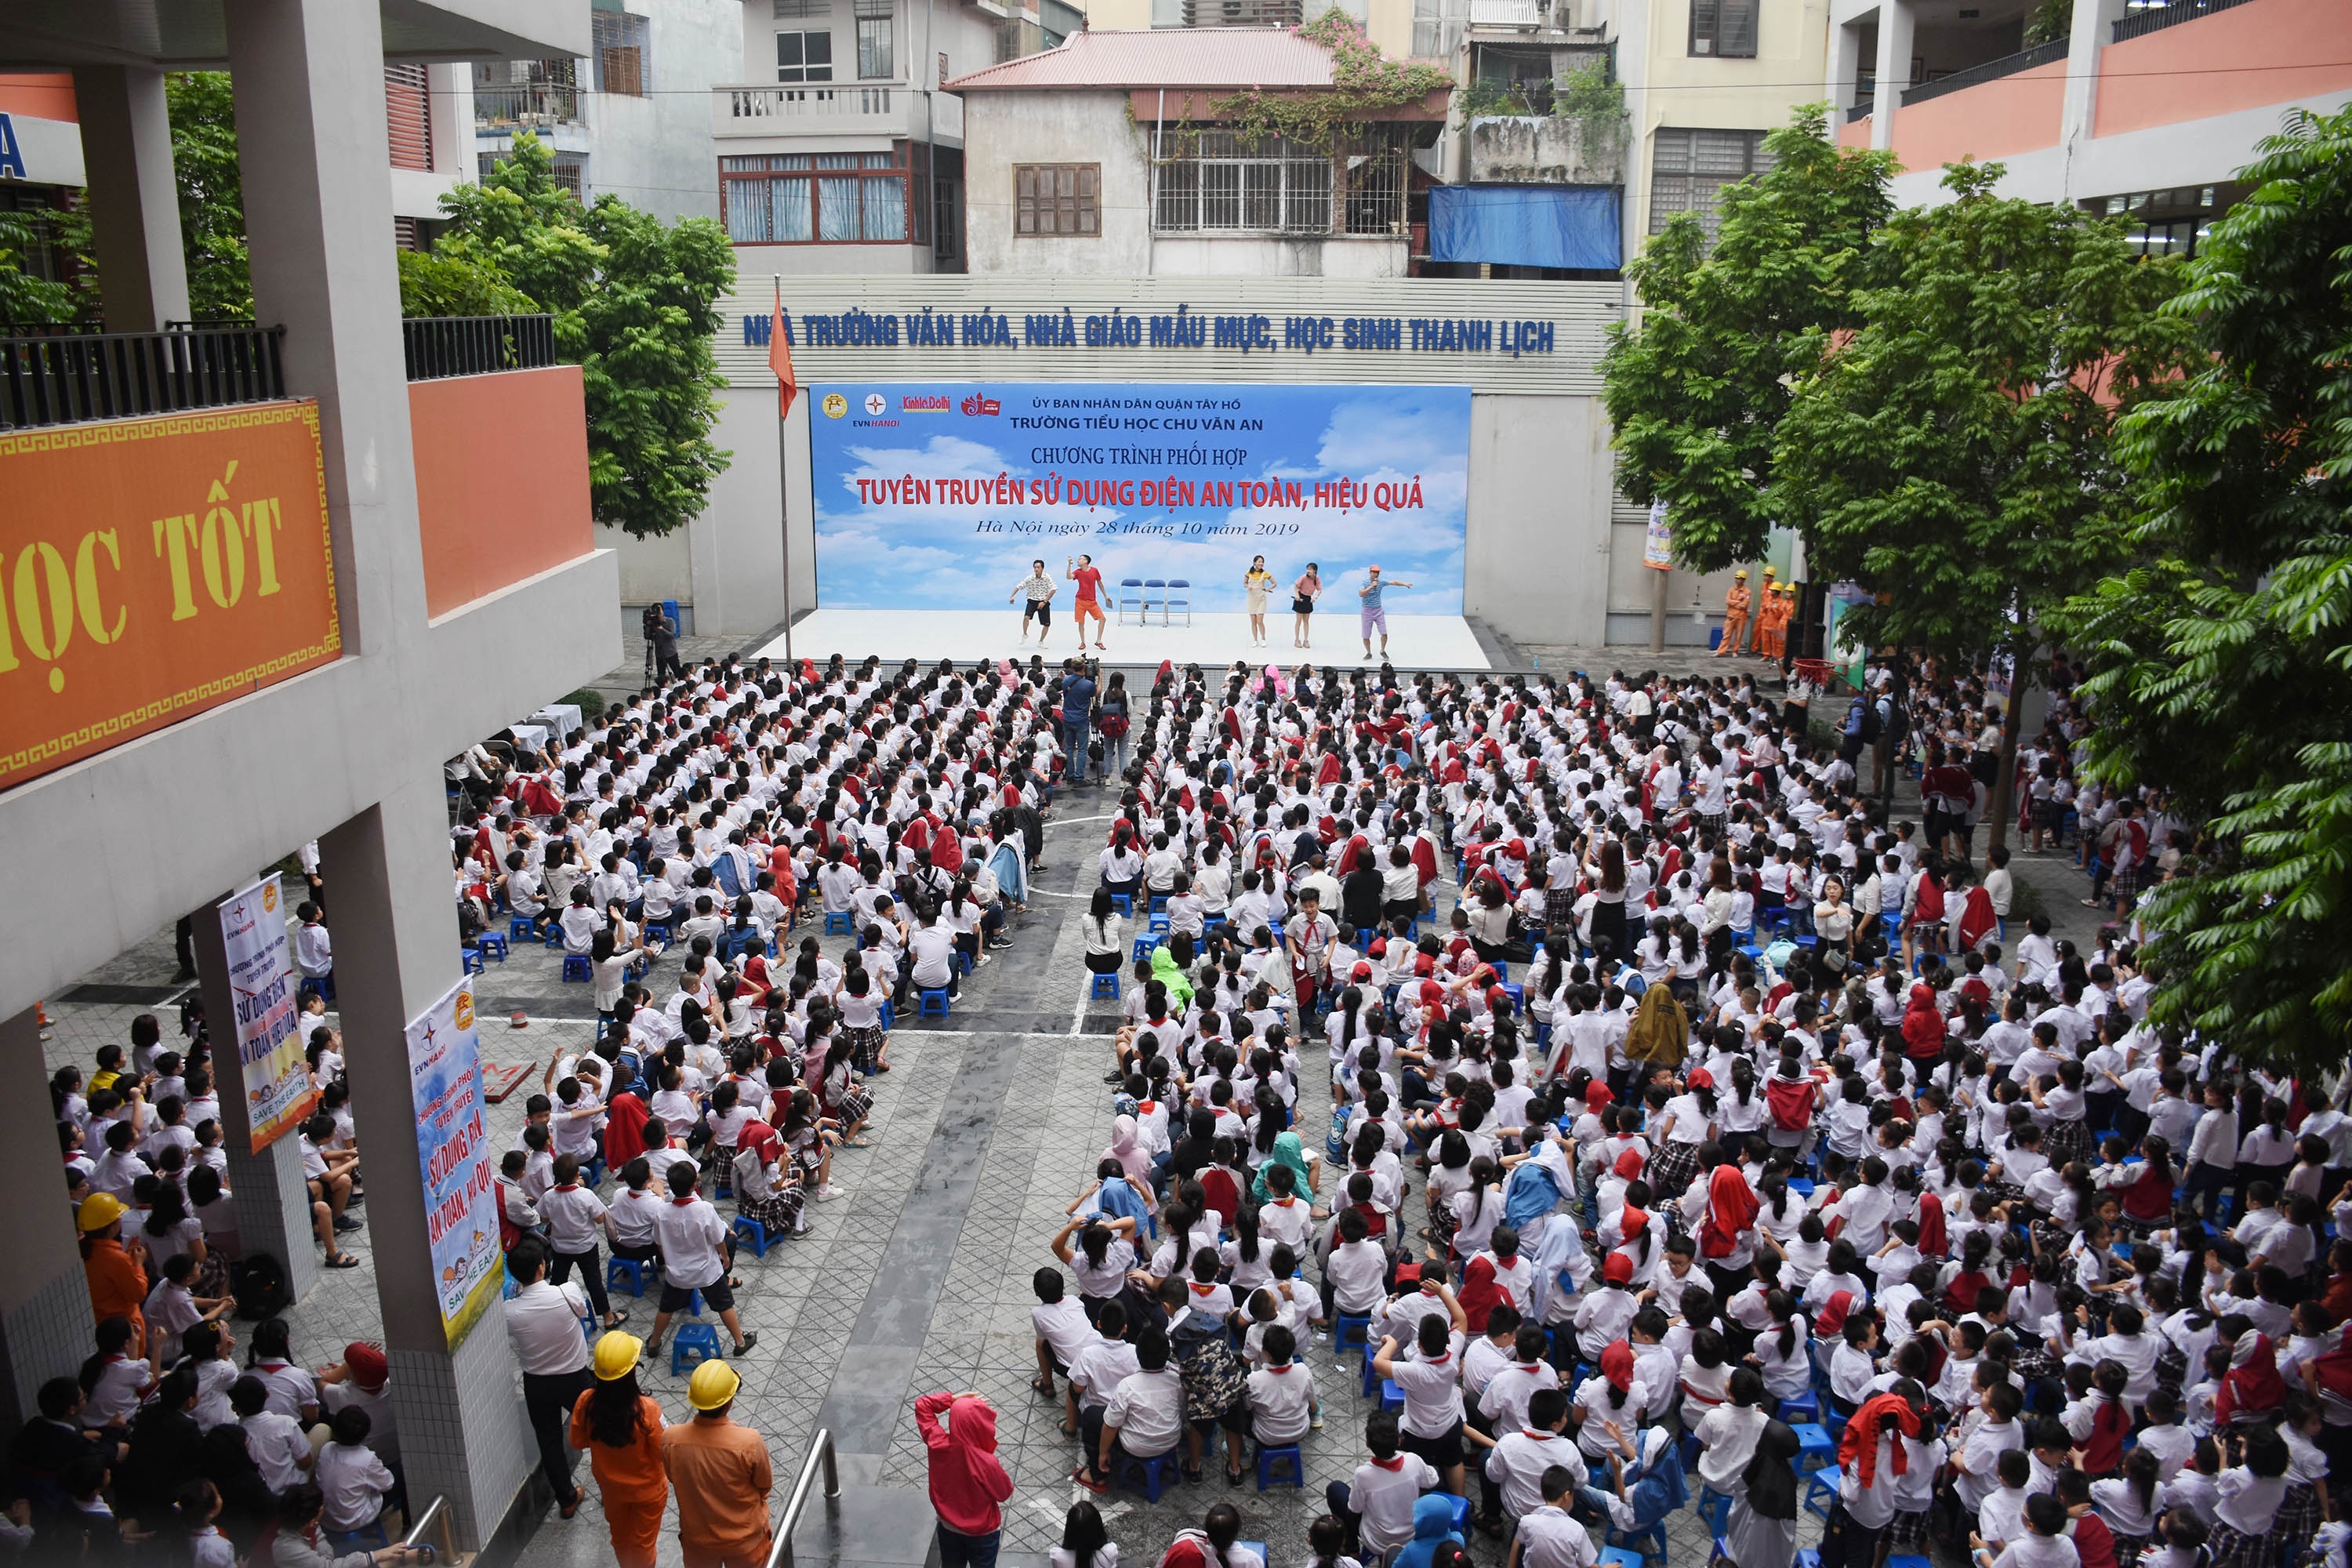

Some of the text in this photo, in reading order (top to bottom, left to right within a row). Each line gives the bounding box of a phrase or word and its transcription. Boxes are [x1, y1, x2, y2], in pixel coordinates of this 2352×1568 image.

[802, 306, 898, 346] TRƯỜNG
[905, 306, 954, 346] VĂN
[962, 306, 1018, 350] HÓA,
[1025, 307, 1077, 346] NHÀ
[1085, 307, 1142, 347] GIÁO
[1149, 303, 1206, 347] MẪU
[1214, 313, 1277, 354] MỰC,
[1285, 316, 1334, 354] HỌC
[1342, 317, 1402, 350] SINH
[1408, 318, 1493, 352] THANH
[1500, 320, 1554, 358] LỊCH
[1010, 413, 1264, 432] TRƯỜNG TIỂU HỌC CHU VĂN AN
[1032, 398, 1050, 408] ỦY
[1053, 399, 1080, 408] BAN
[1083, 399, 1121, 409] NHÂN
[1123, 399, 1152, 409] DÂN
[1155, 399, 1193, 412] QUẬN
[1196, 399, 1218, 409] TÂY
[1031, 440, 1248, 470] CHƯƠNG TRÌNH PHỐI HỢP
[857, 470, 1424, 515] TUYÊN TRUYỀN SỬ DỤNG ĐIỆN AN TOÀN, HIỆU QUẢ
[152, 459, 282, 622] TỐT
[975, 520, 1300, 538] Hà Nội ngày 28 tháng 10 năm 2019
[253, 1078, 306, 1123] SAVE THE EARTH
[441, 1128, 469, 1176] DỤNG
[430, 1210, 443, 1246] AN
[448, 1287, 466, 1310] SAV
